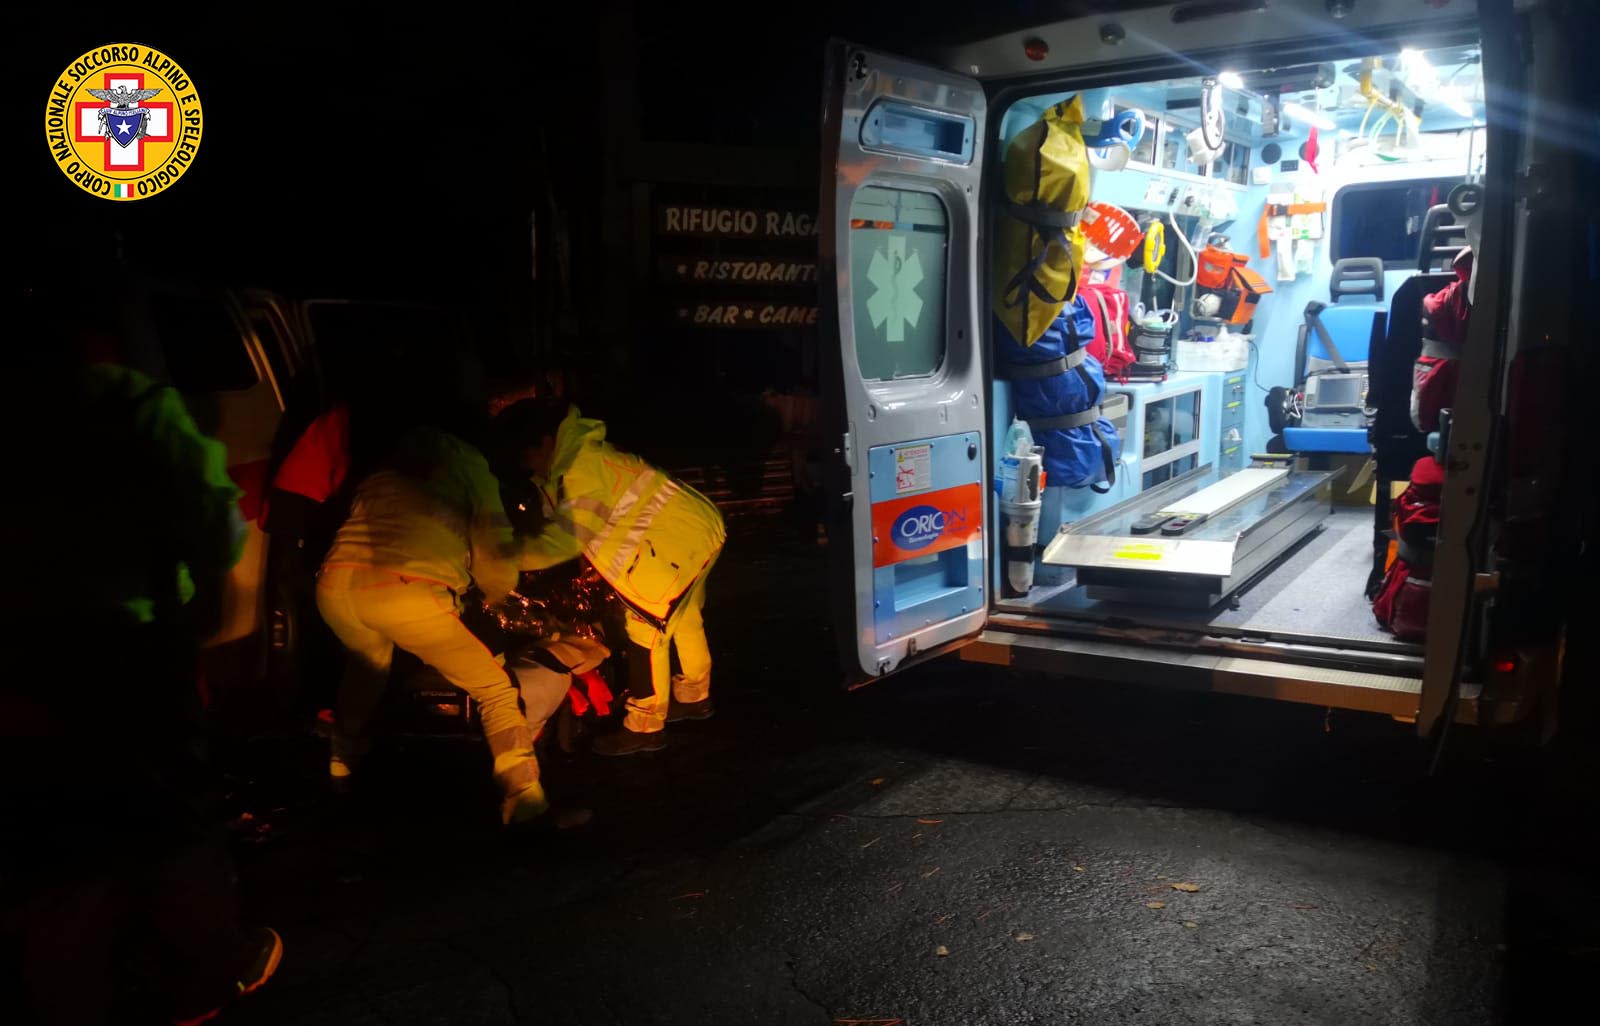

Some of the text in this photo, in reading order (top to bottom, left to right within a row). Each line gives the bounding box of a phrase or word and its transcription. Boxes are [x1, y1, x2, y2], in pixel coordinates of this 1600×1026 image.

[665, 207, 757, 234] RIFUGIO
[693, 261, 818, 281] RISTORANT
[693, 305, 819, 324] BAR CAME
